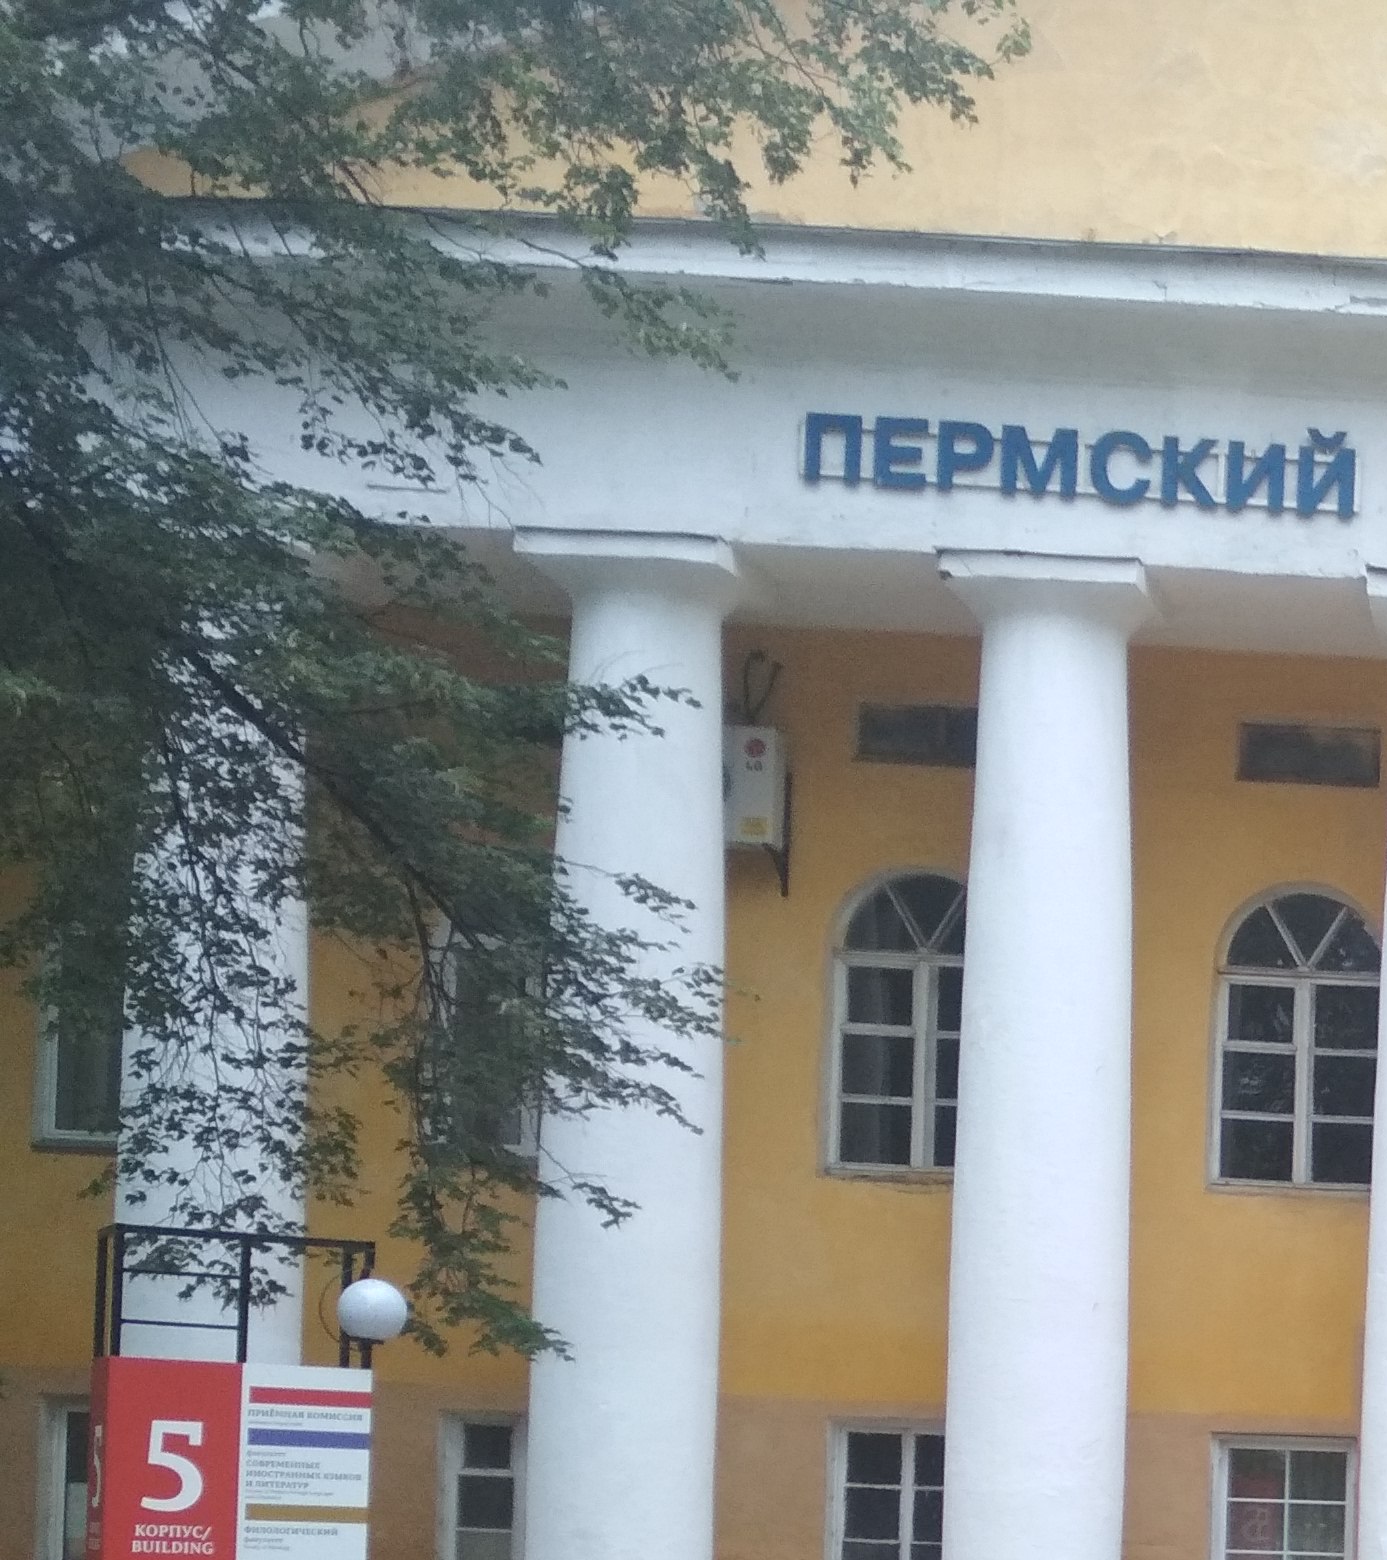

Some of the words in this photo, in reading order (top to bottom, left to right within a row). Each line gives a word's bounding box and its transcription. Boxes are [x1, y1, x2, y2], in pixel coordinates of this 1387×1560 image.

[804, 411, 1357, 520] ПЕРМСКИЙ
[140, 1419, 204, 1512] 5
[131, 1539, 215, 1556] BUILDING
[134, 1524, 213, 1541] КОРПУС/
